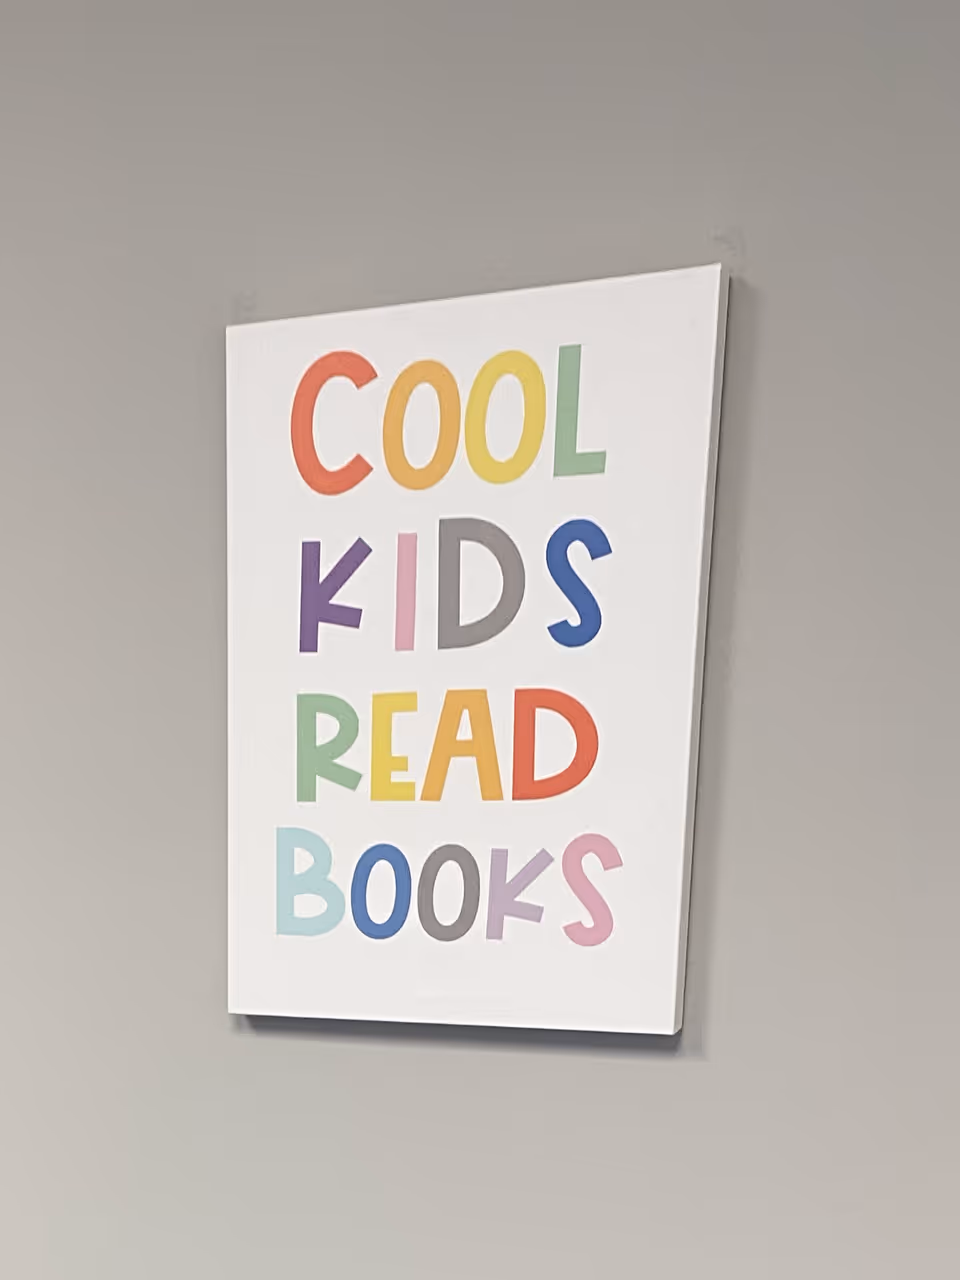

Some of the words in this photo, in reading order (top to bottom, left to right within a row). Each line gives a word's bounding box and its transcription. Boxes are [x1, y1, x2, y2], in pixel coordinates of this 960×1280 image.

[290, 344, 606, 496] COOL
[298, 517, 613, 653] KIDS
[295, 688, 600, 803] READ
[275, 826, 624, 948] BOOKS
